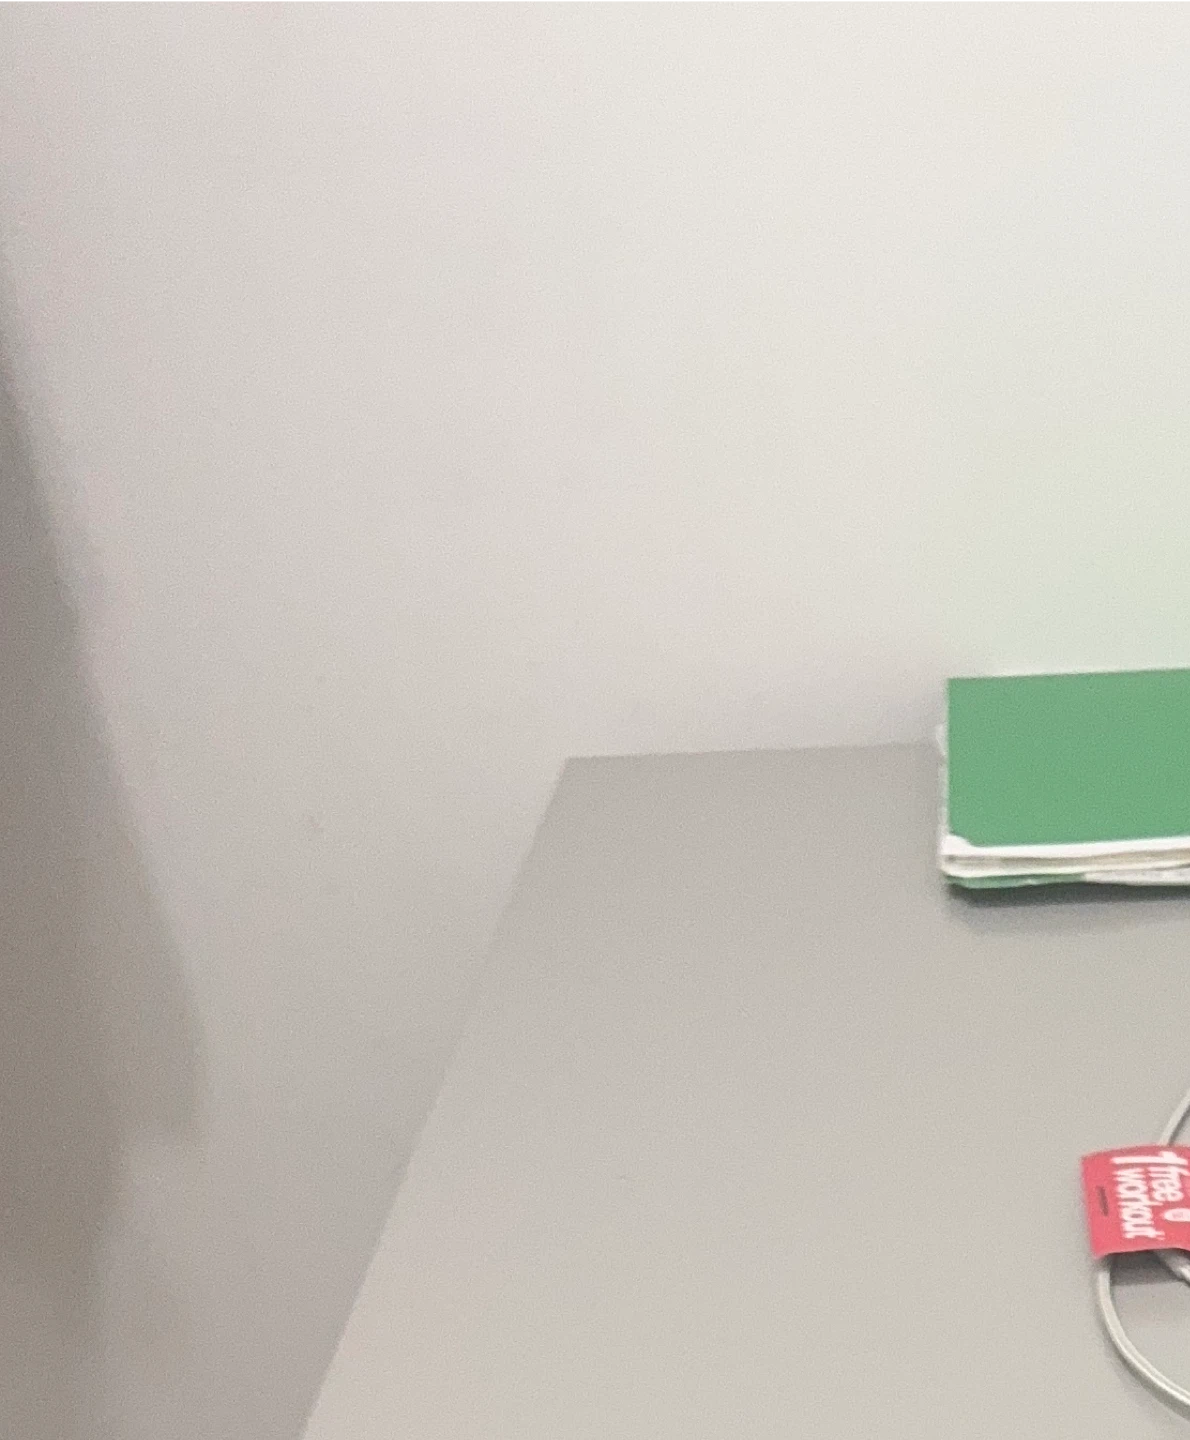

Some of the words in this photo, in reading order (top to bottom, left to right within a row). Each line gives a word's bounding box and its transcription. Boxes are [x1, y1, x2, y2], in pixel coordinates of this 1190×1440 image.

[1110, 1151, 1189, 1165] 1
[1147, 1166, 1190, 1202] free
[1112, 1168, 1165, 1239] workout
